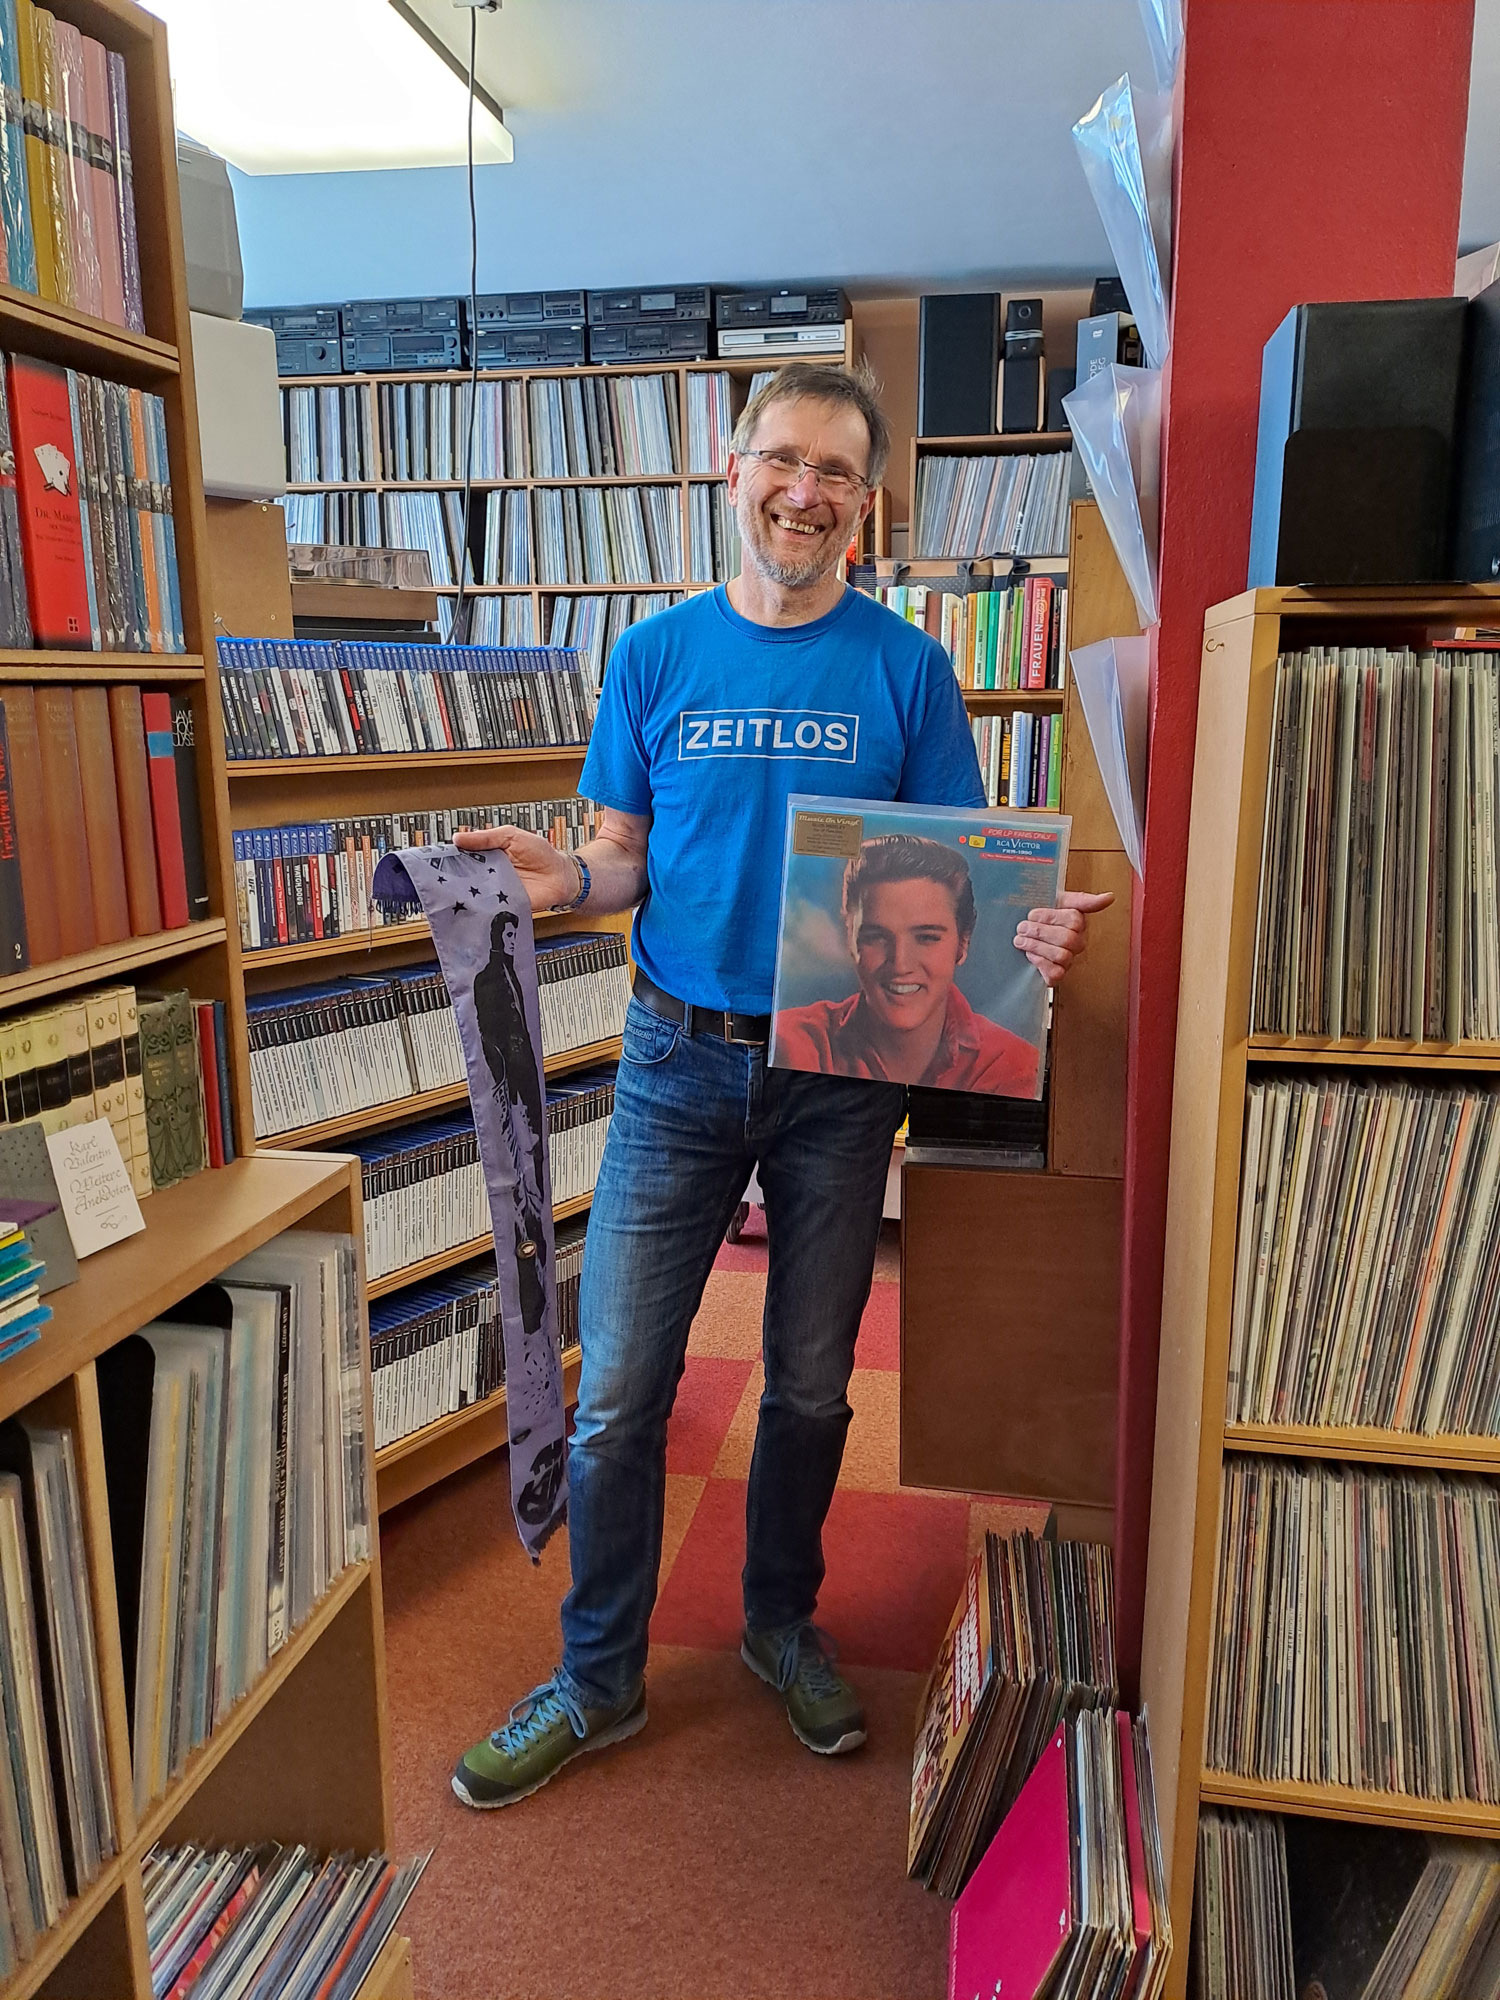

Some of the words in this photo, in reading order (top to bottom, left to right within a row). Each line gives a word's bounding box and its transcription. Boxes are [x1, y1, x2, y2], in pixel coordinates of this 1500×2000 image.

[1032, 624, 1044, 678] FRAUEN
[396, 700, 406, 725] HONOR
[686, 719, 848, 750] ZEITLOS
[1011, 838, 1040, 849] VICTOR
[14, 944, 22, 960] 2
